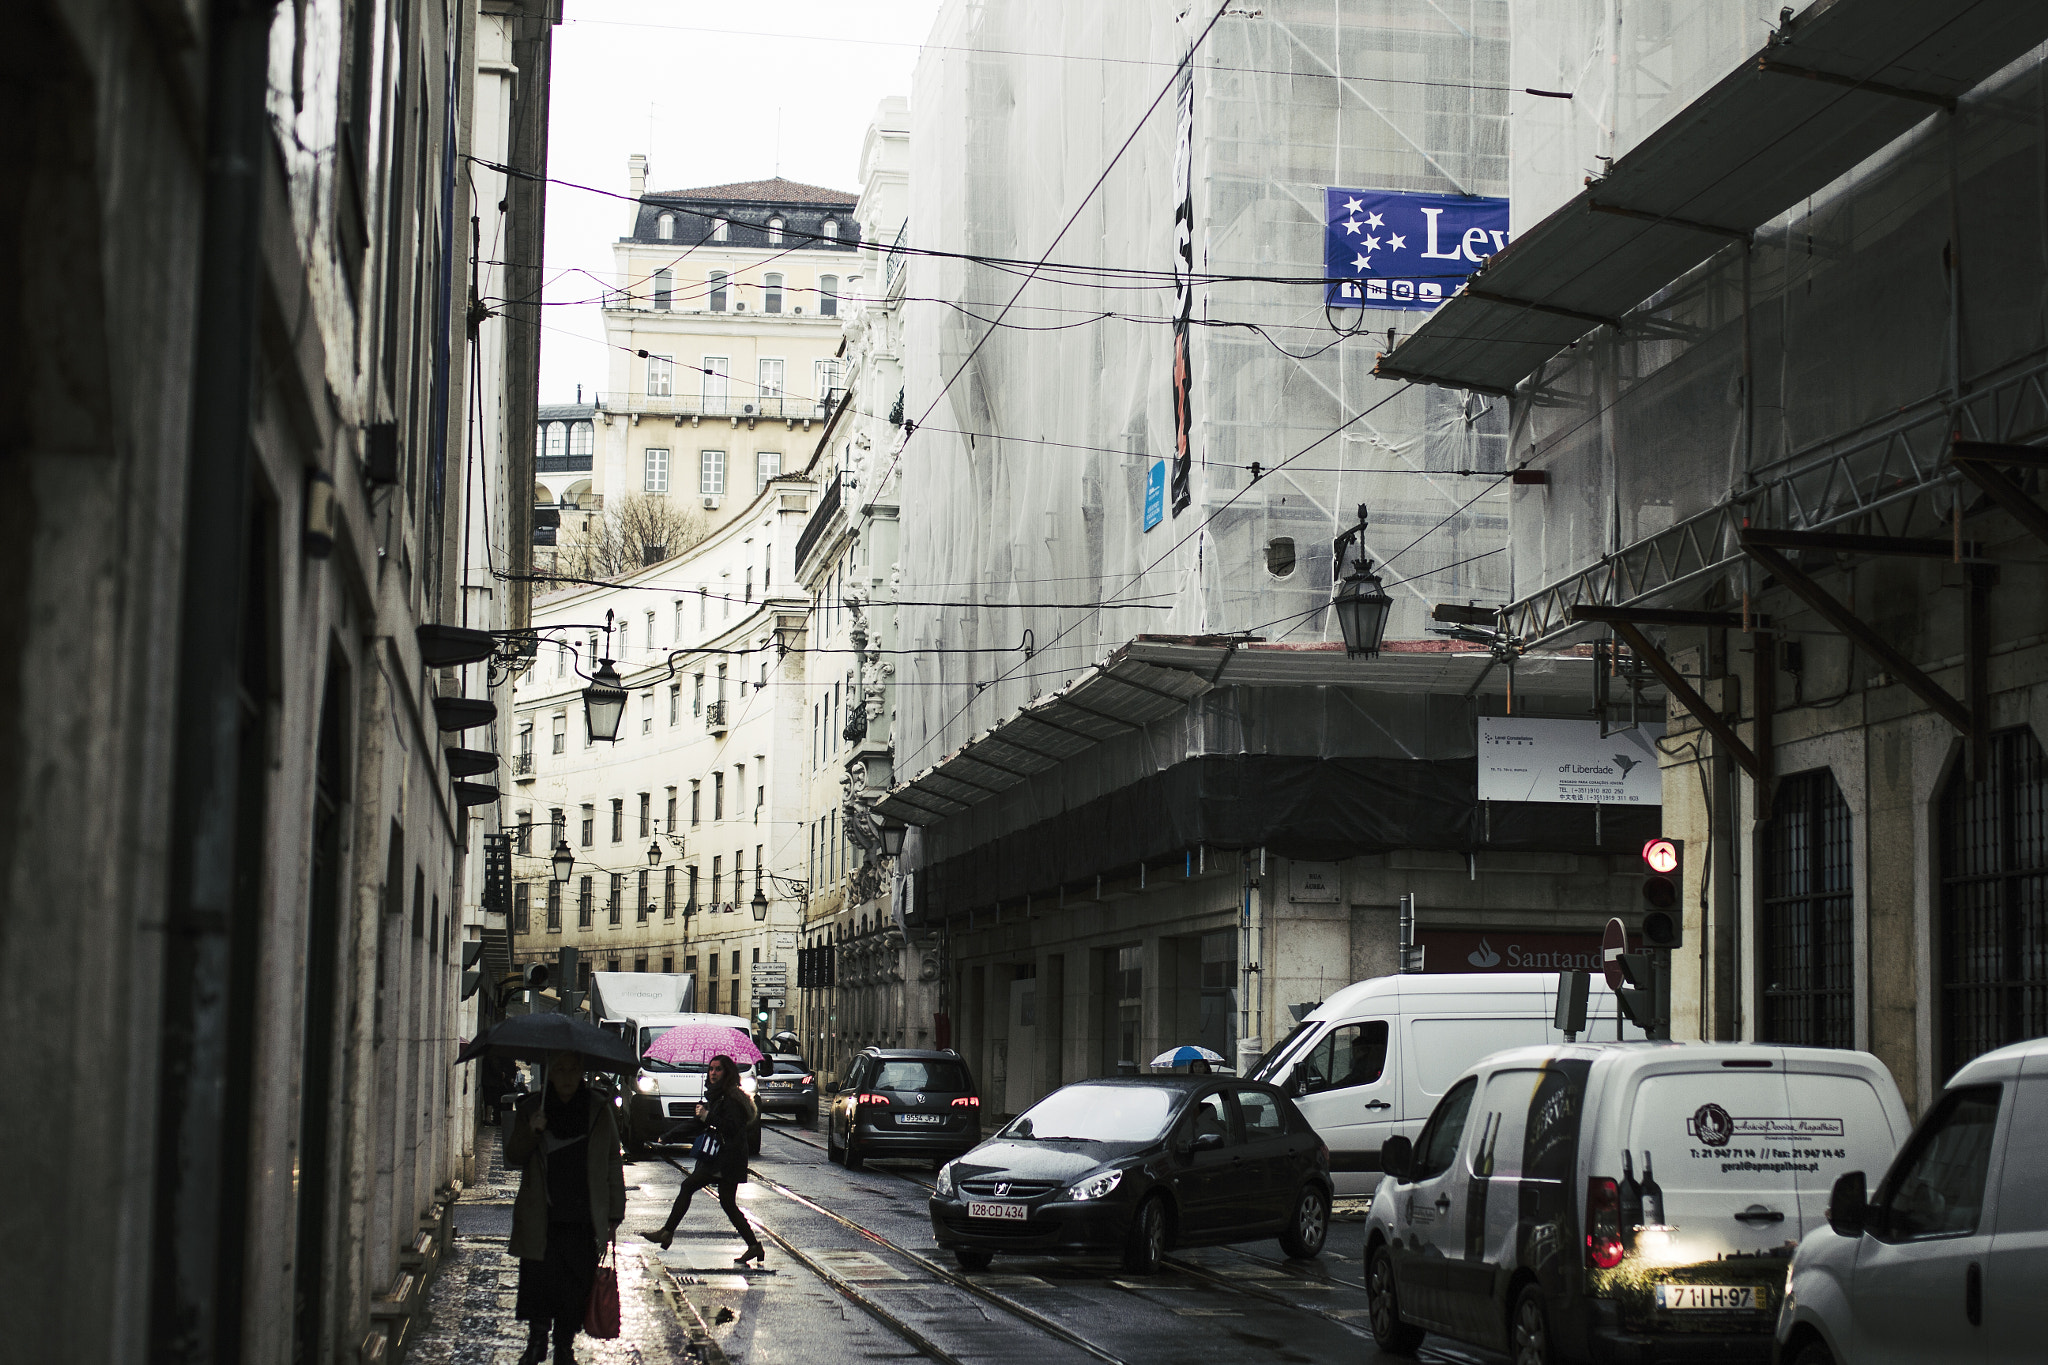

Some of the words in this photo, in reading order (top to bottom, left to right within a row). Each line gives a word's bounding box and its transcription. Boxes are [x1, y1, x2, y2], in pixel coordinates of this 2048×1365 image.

[1558, 763, 1571, 773] off
[1572, 764, 1614, 775] Liberdade
[1507, 944, 1604, 969] Santand
[906, 1113, 923, 1121] 9554
[1690, 1149, 1700, 1158] T:
[1701, 1149, 1712, 1158] 21
[1713, 1149, 1732, 1158] 947
[1733, 1149, 1743, 1158] 71
[1745, 1149, 1756, 1158] 14
[1772, 1149, 1791, 1158] Fax:
[1792, 1149, 1802, 1158] 21
[1803, 1149, 1821, 1158] 947
[1822, 1149, 1832, 1158] 14
[1834, 1149, 1846, 1158] 45
[1005, 1206, 1024, 1219] 434
